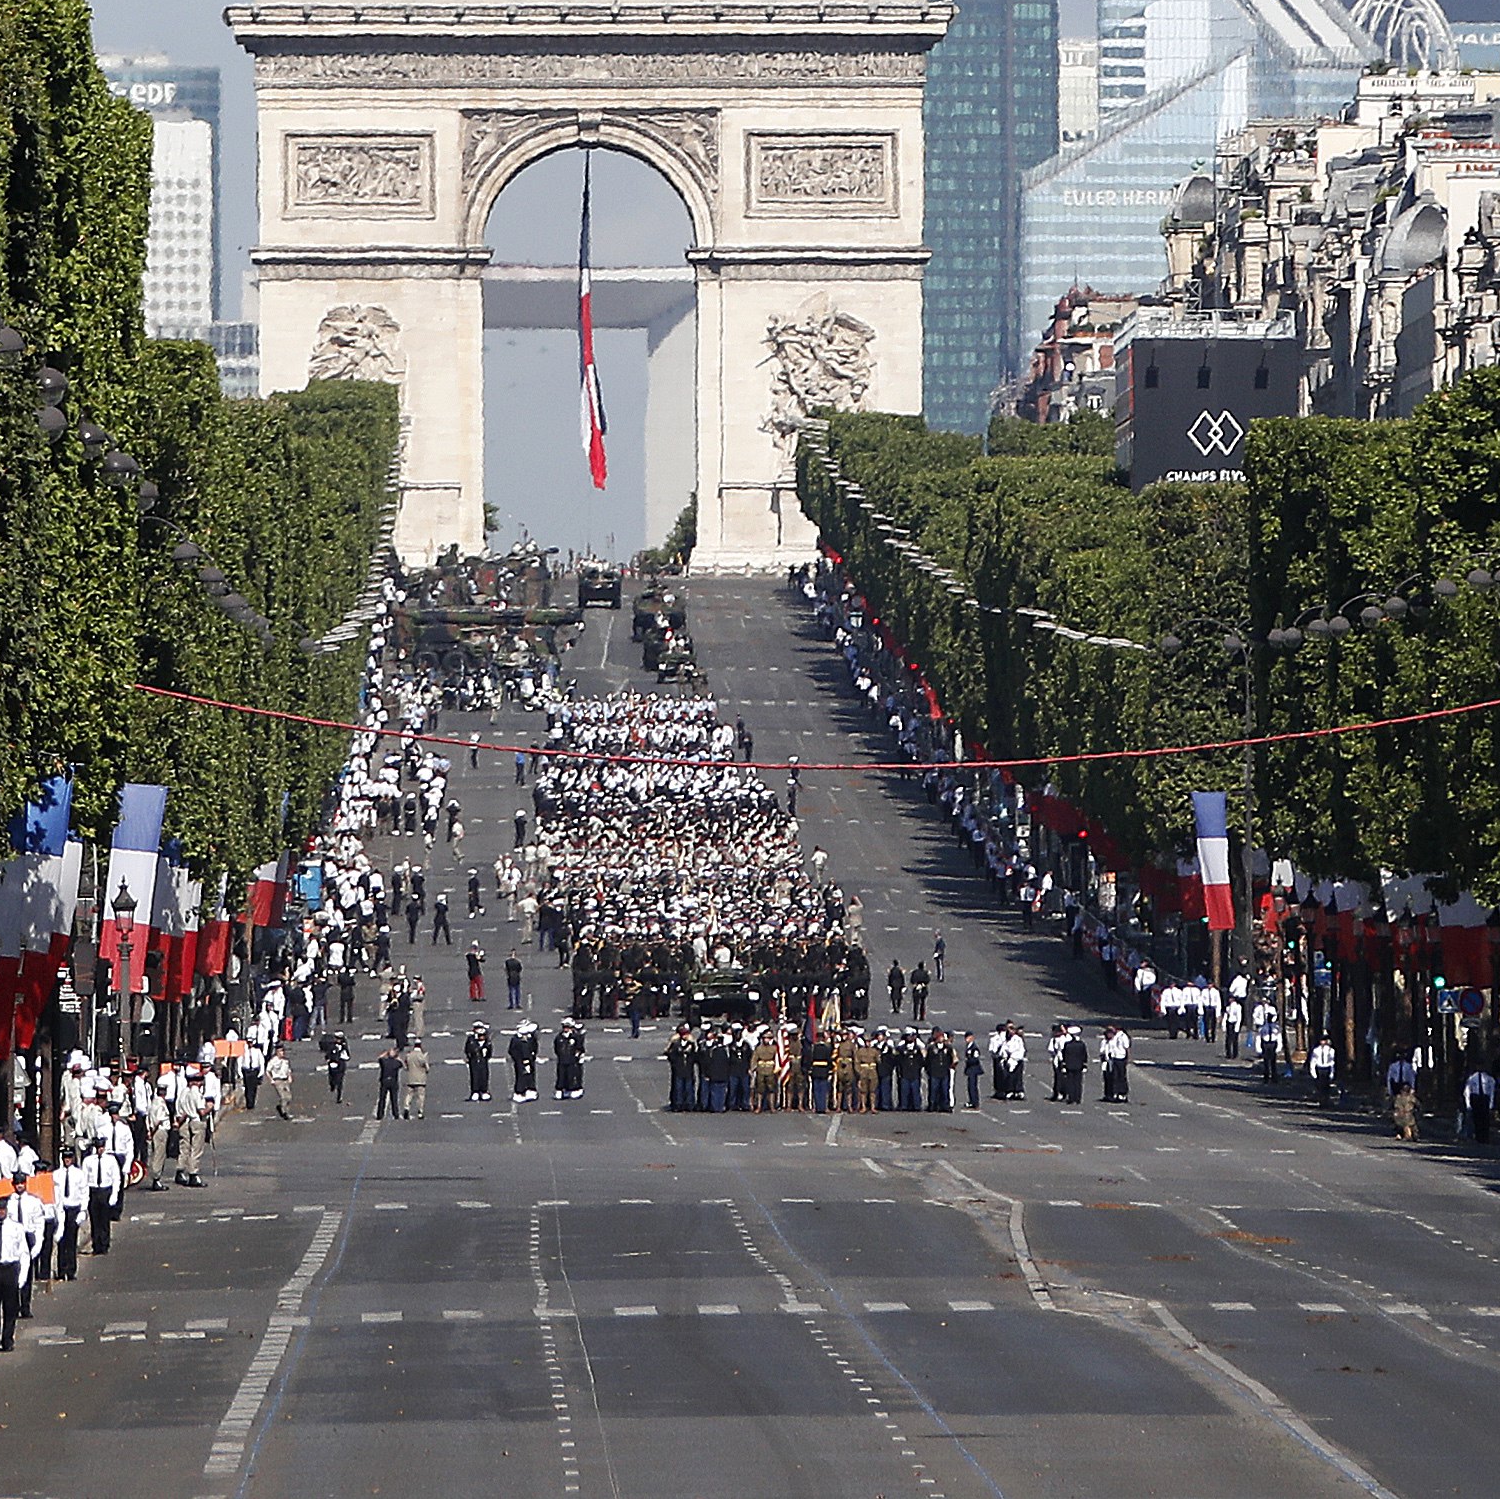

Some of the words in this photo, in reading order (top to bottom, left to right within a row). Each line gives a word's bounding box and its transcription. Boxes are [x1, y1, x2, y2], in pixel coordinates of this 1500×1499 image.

[1064, 190, 1117, 206] EULER
[1123, 190, 1173, 206] HERM
[1166, 470, 1218, 482] CHAMPS
[1220, 469, 1248, 482] ELYS
